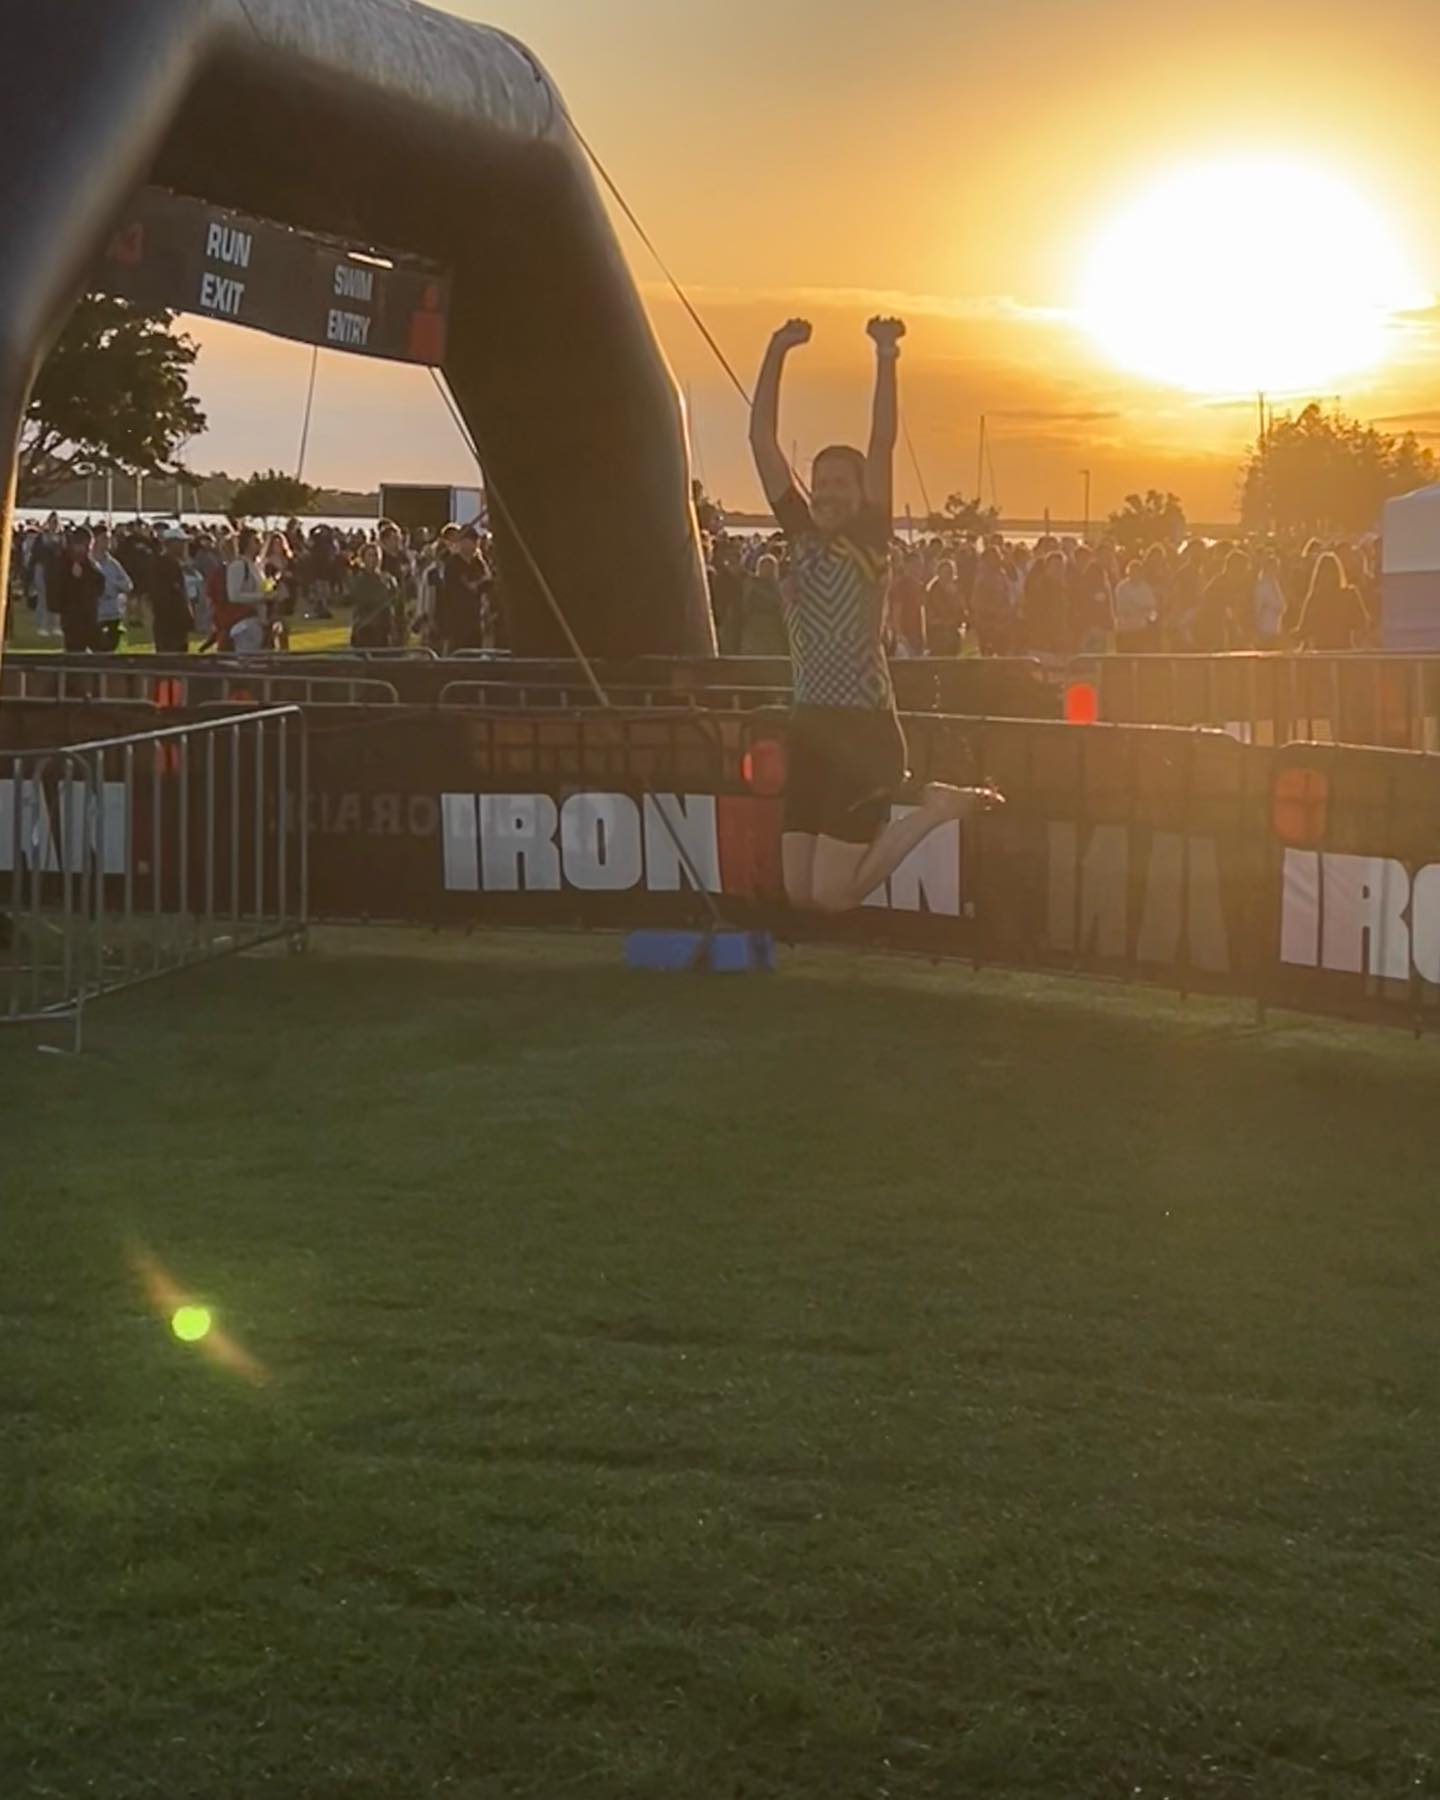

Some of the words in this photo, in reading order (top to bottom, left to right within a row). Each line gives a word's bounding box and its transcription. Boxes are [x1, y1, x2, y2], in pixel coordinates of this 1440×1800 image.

[206, 222, 252, 268] RUN
[200, 272, 245, 315] EXIT
[334, 264, 374, 301] SWIM
[327, 309, 371, 345] ENTRY
